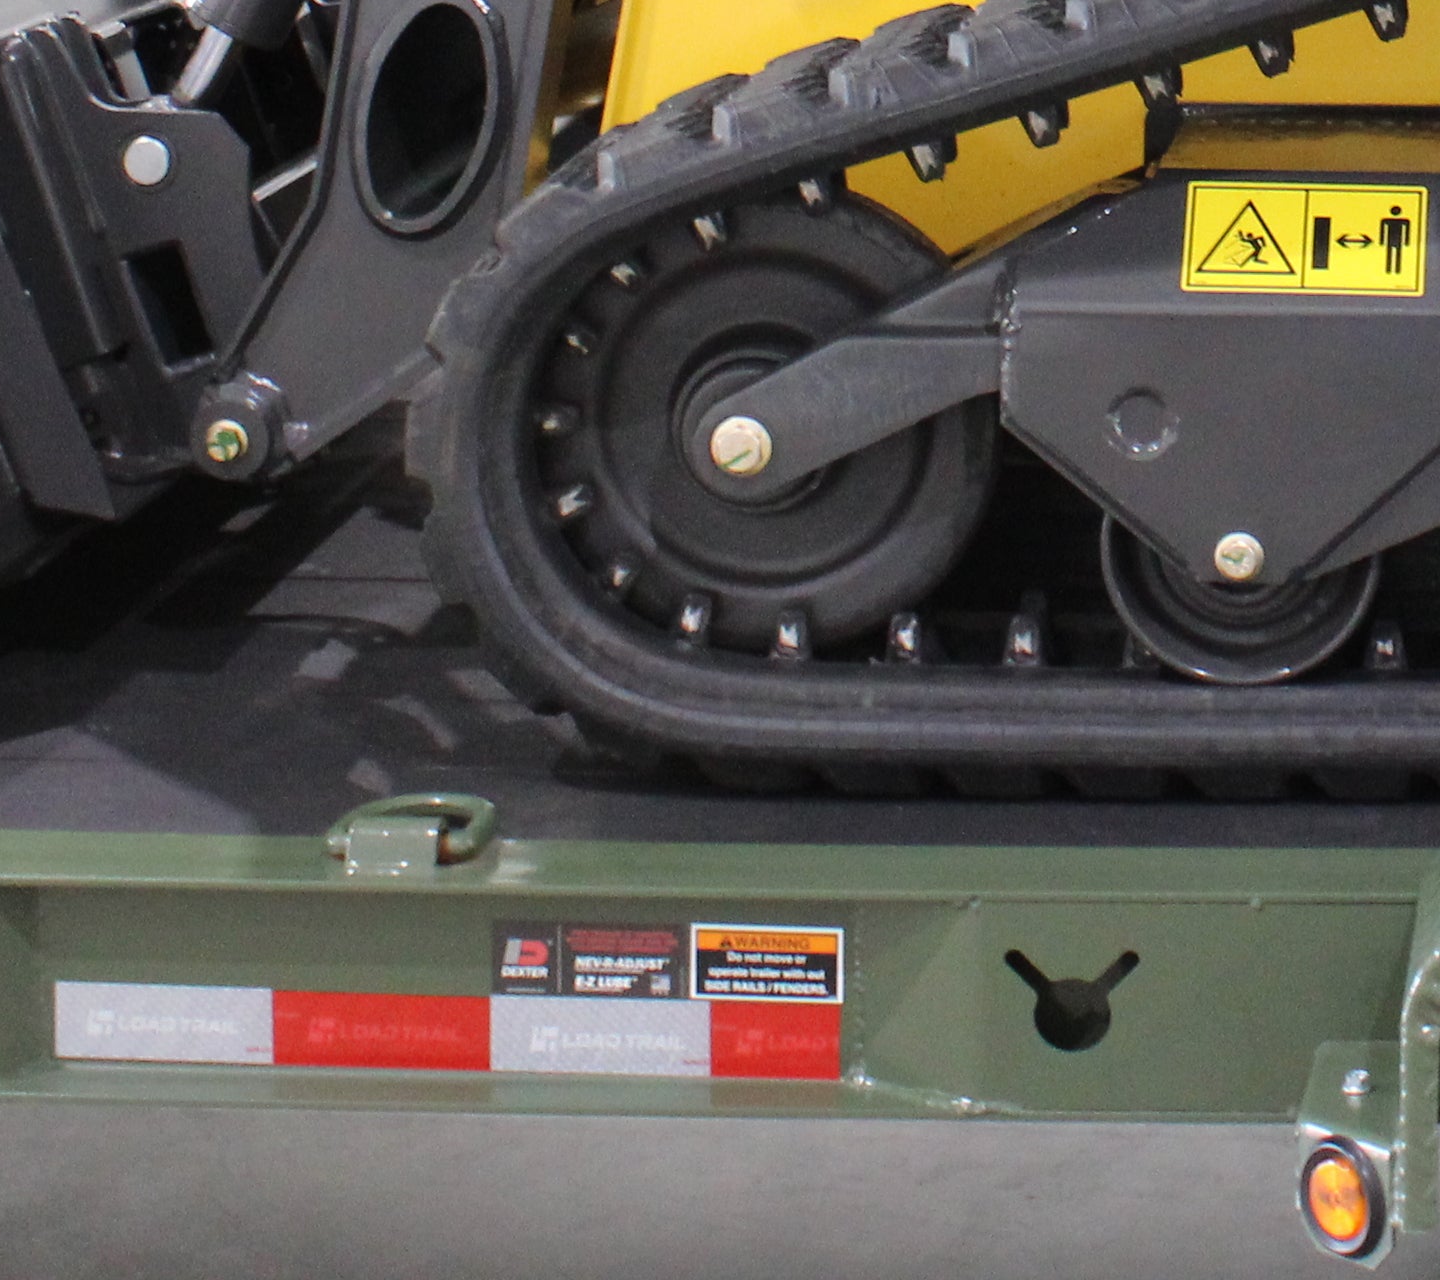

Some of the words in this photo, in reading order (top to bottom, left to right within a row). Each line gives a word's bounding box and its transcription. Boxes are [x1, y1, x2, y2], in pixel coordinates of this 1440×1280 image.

[734, 936, 810, 950] WARNING
[726, 951, 743, 962] Do
[743, 952, 763, 963] not
[763, 954, 794, 965] move
[794, 955, 807, 965] or
[501, 965, 549, 979] DEXTER
[707, 966, 749, 979] operate
[749, 967, 781, 979] trailer
[781, 968, 806, 980] with
[806, 969, 826, 980] out
[704, 979, 731, 992] SIDE
